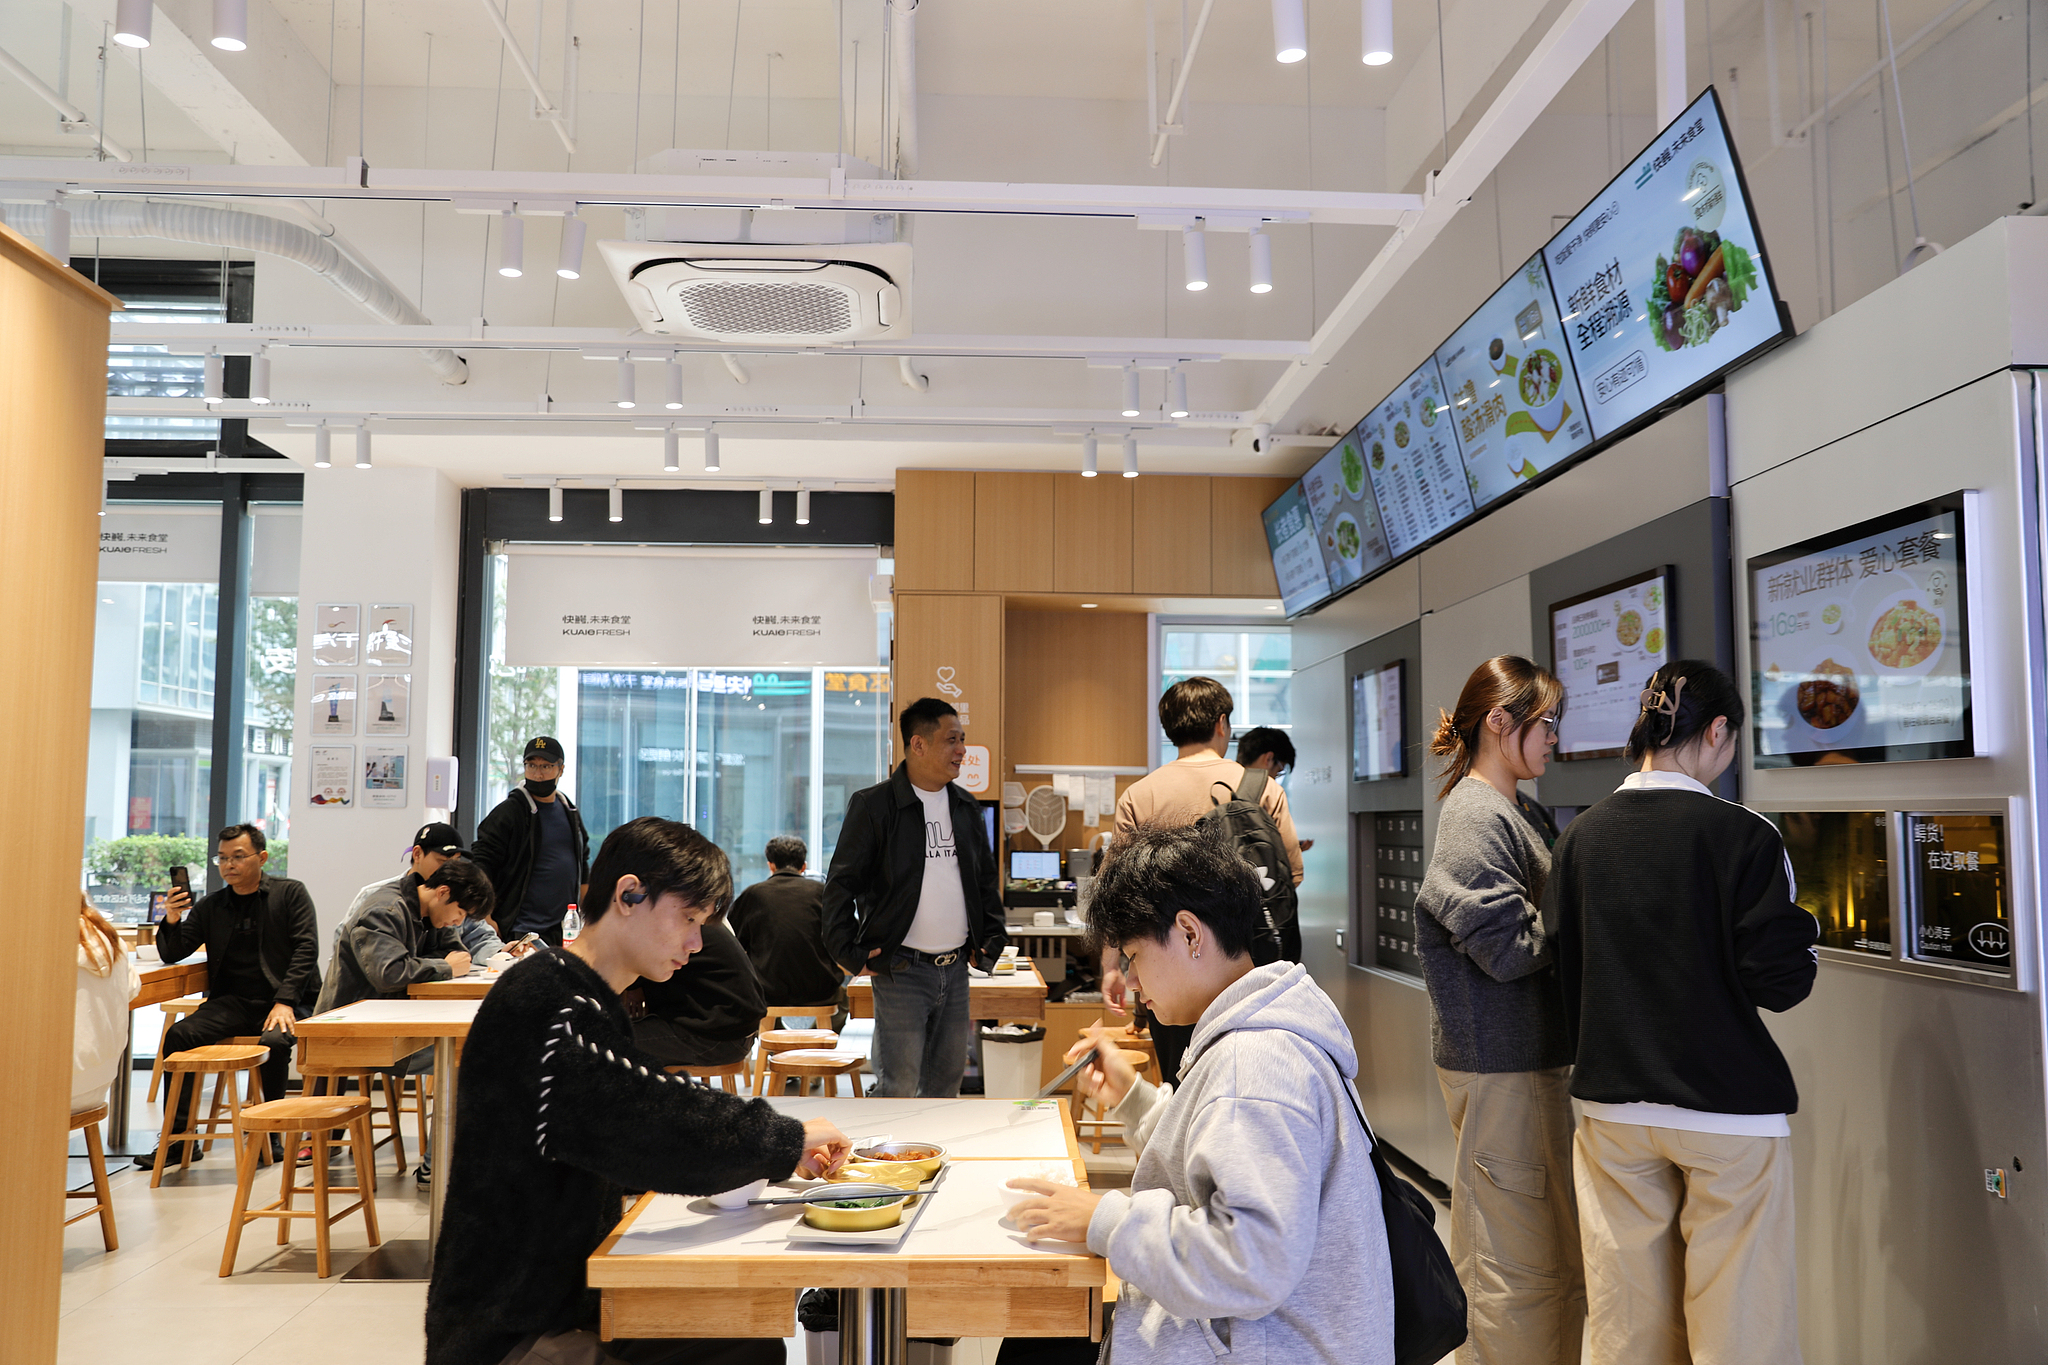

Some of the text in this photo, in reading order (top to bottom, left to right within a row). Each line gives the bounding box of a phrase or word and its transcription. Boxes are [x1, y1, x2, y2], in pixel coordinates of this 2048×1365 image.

[1567, 257, 1623, 321] 新鲜食材
[1577, 289, 1633, 351] 全程溯源
[1767, 529, 1941, 602] 新就业群体 爱心套餐
[1927, 850, 1979, 871] 在这取餐
[1919, 924, 1951, 939] 小心烫手
